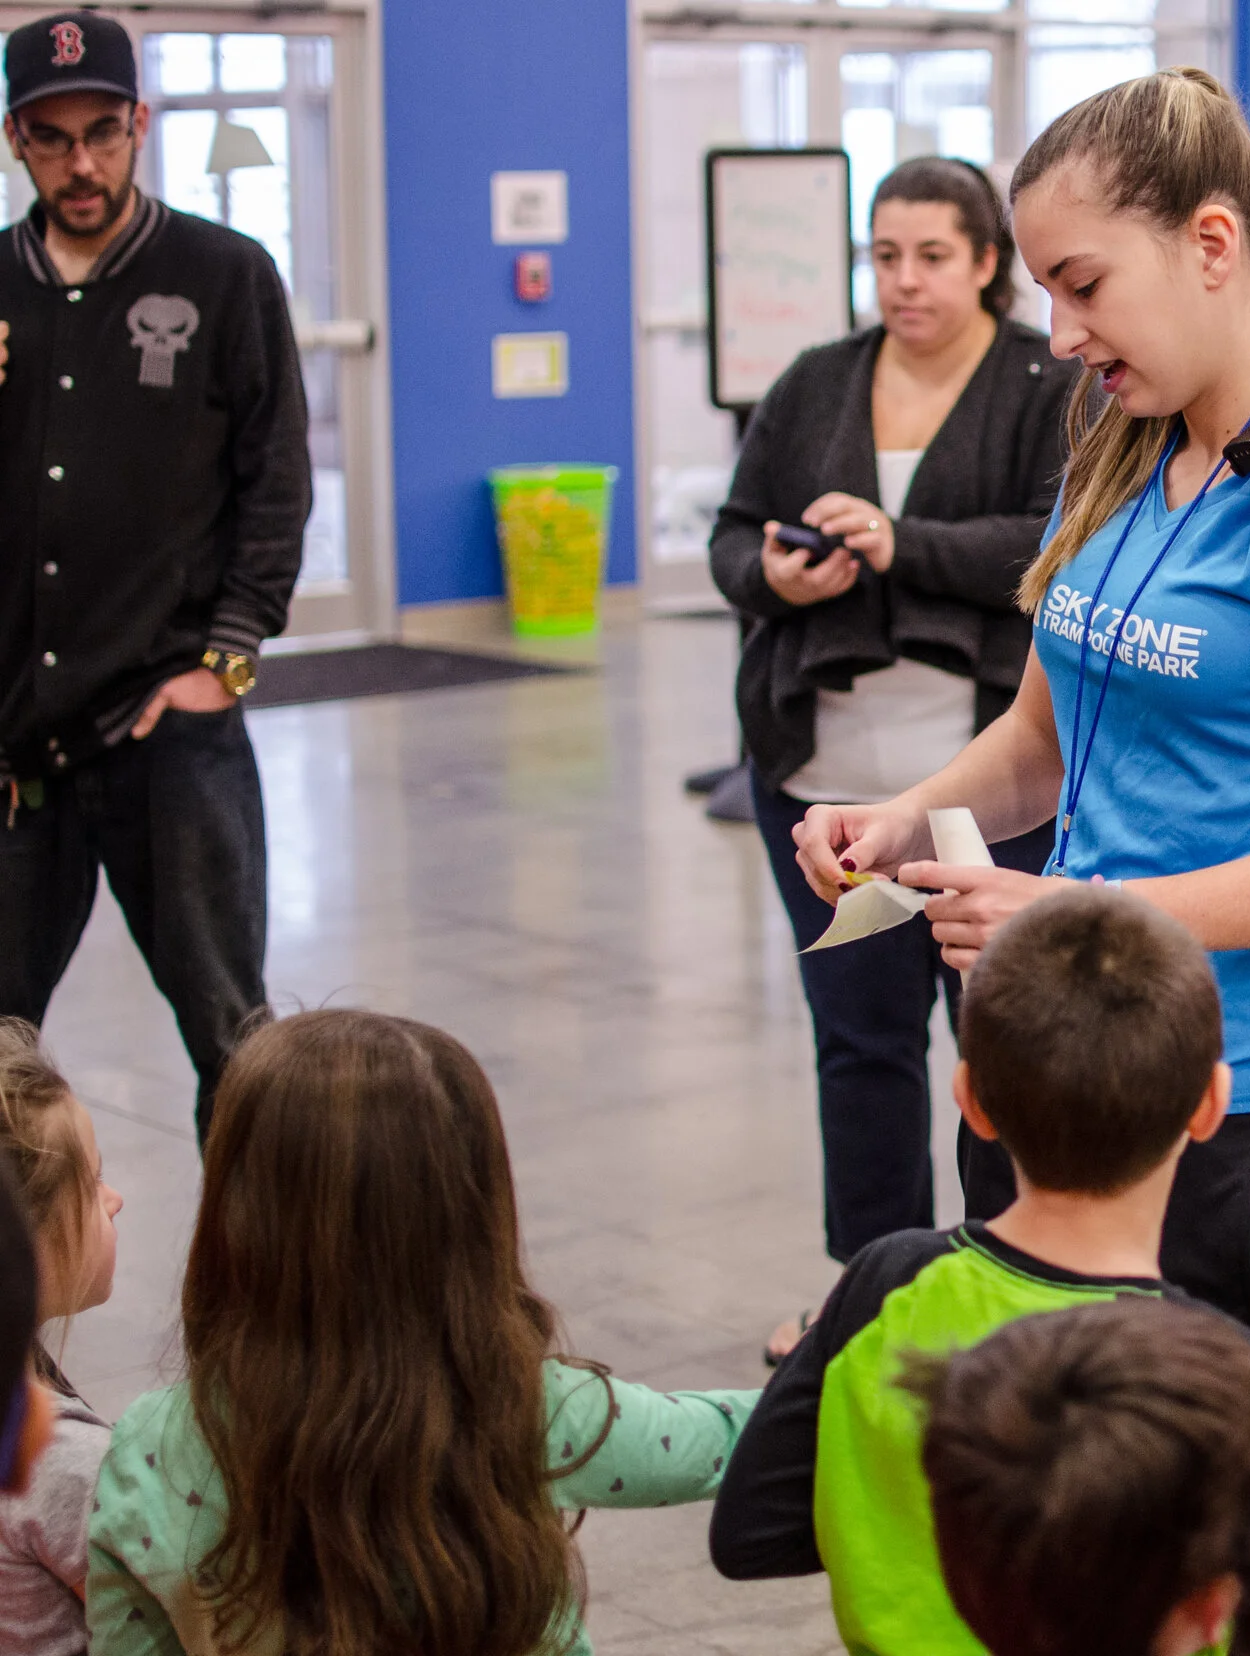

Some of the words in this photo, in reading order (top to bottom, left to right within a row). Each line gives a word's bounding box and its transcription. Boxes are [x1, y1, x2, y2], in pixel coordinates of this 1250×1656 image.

[1048, 584, 1108, 627] SKY
[1105, 608, 1202, 657] ZONE
[1137, 649, 1199, 679] PARK
